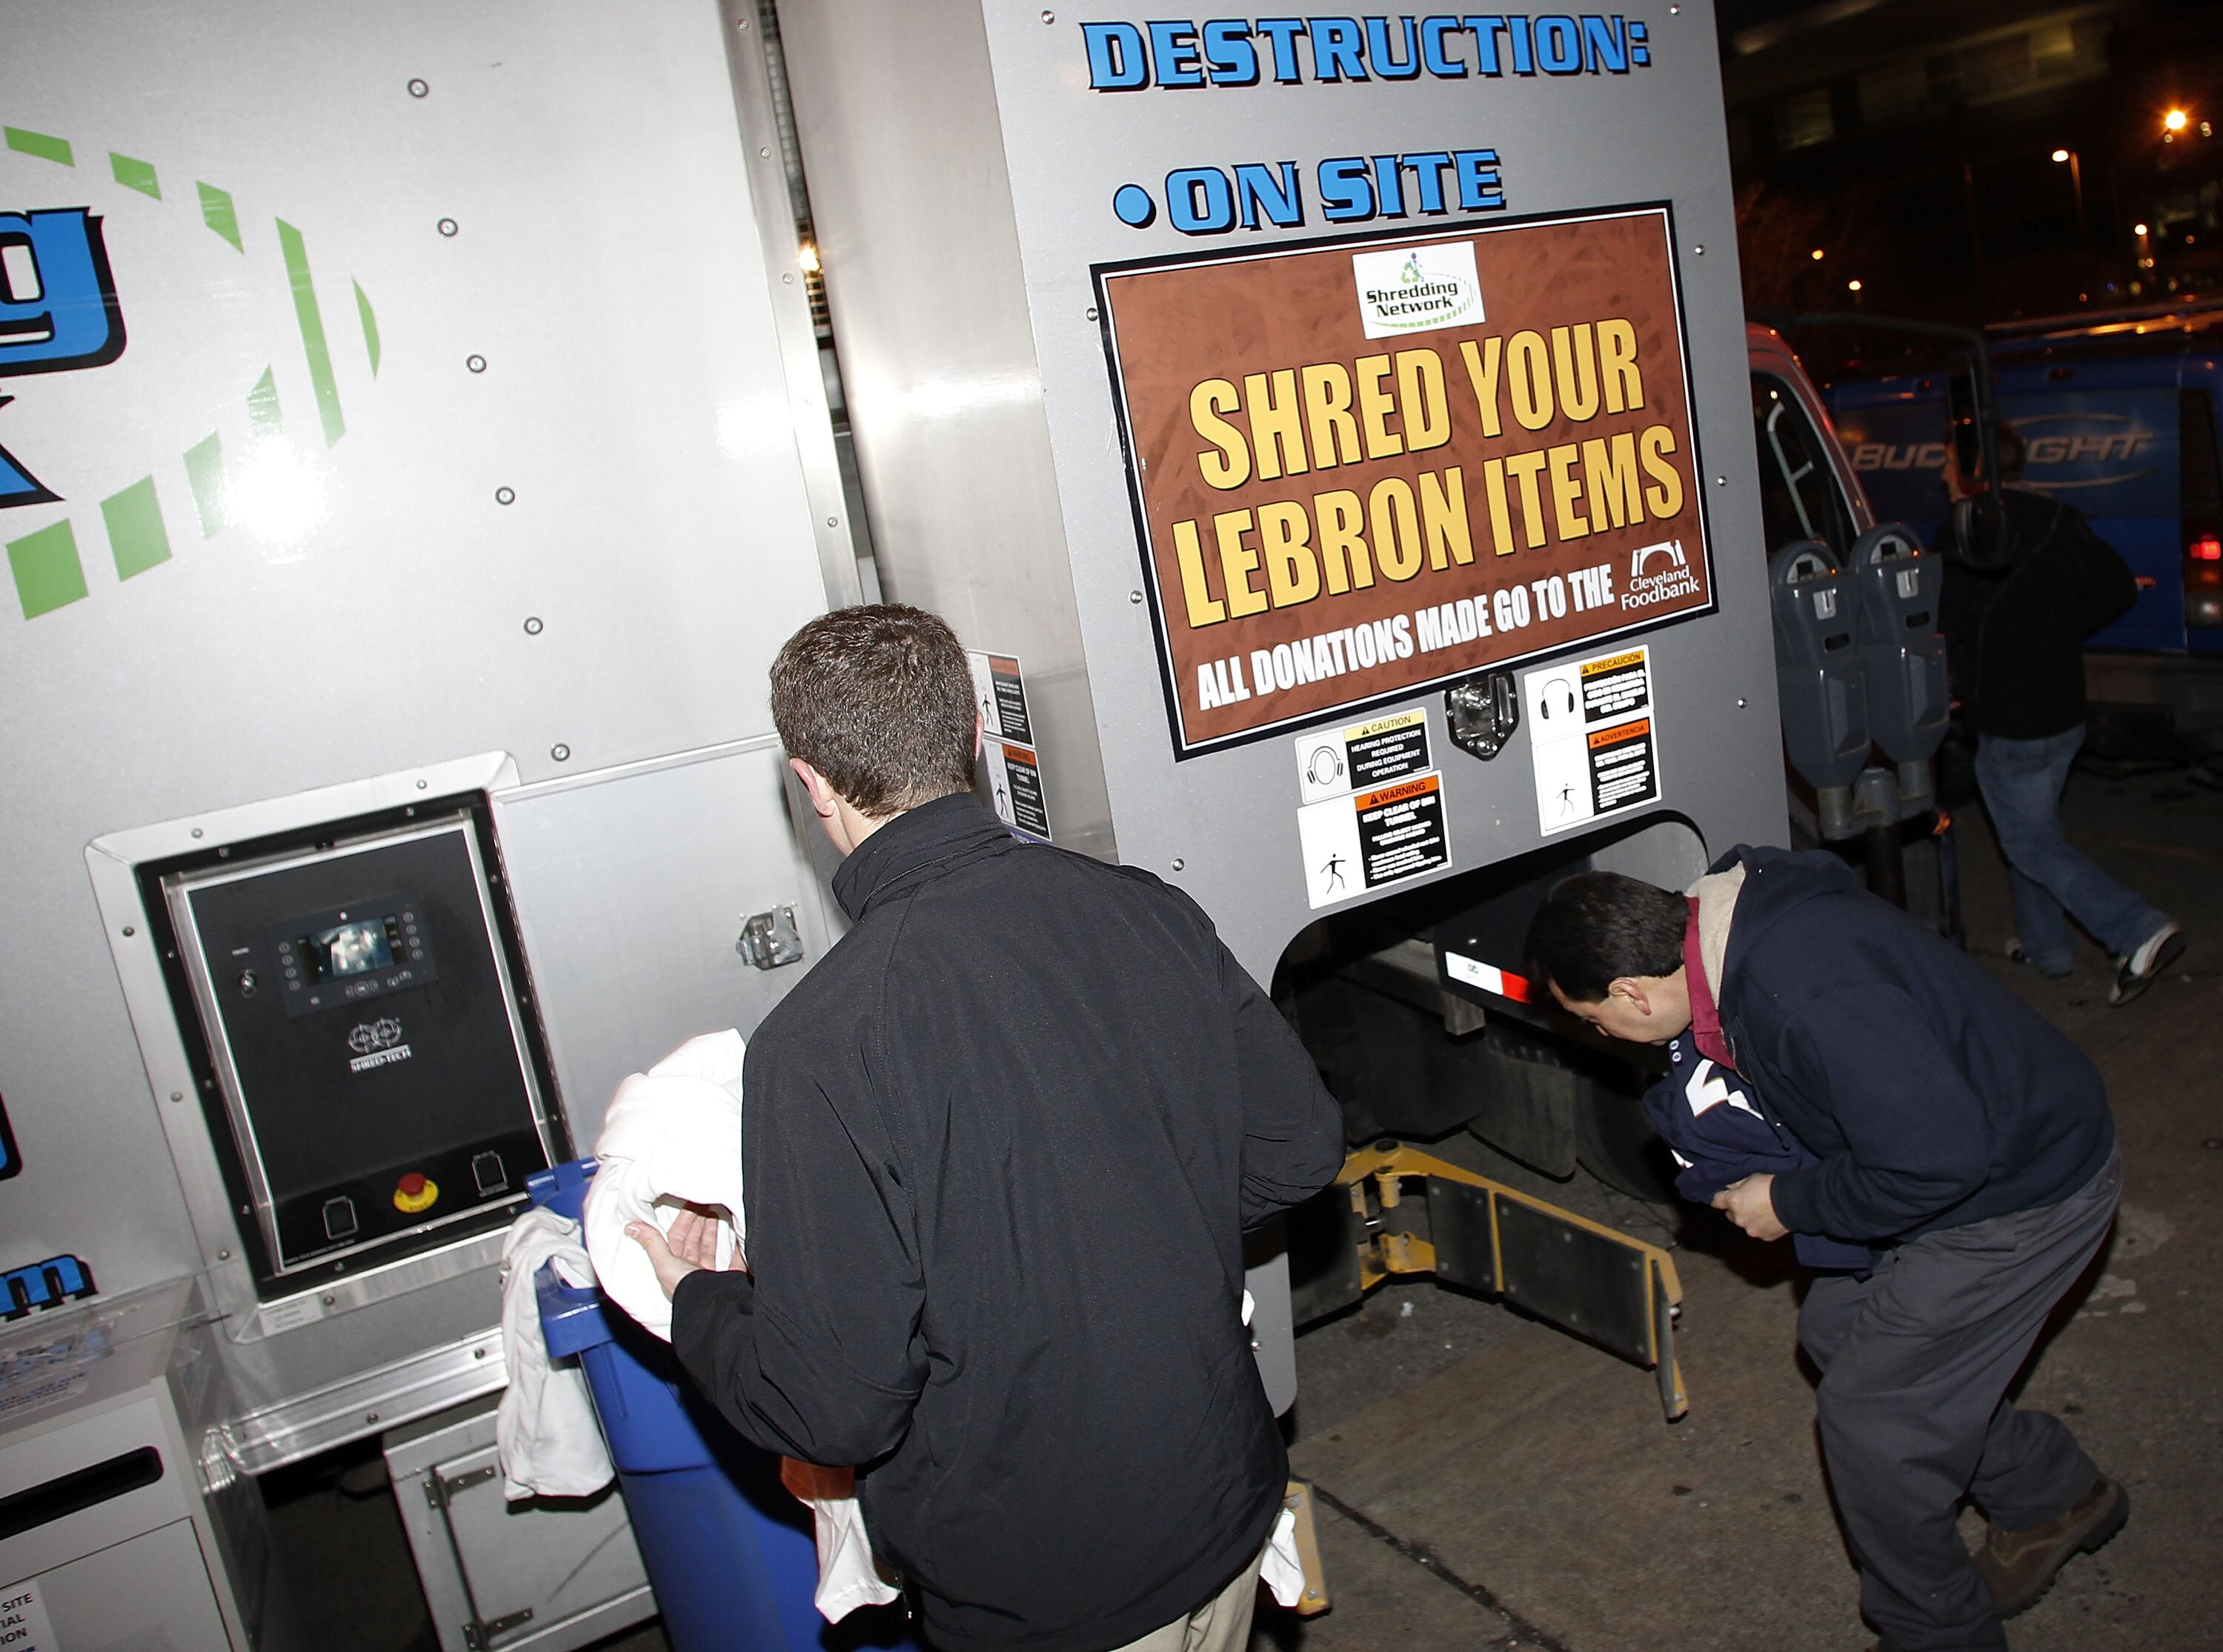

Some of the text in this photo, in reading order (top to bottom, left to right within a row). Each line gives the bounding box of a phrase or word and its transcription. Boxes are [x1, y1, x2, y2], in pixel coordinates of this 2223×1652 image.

[1080, 15, 1651, 93] DESTRUCTION:
[1164, 148, 1506, 235] ON SITE
[1366, 282, 1458, 304] Shredding
[1376, 296, 1453, 318] Network
[1189, 319, 1645, 490] SHRED YOUR
[1172, 424, 1684, 629] LEBRON ITEMS
[1629, 564, 1690, 592] Cleveland
[1621, 576, 1701, 611] Foodbank
[1197, 563, 1615, 712] ALL DONATIONS MADE GO TO THE
[1592, 653, 1641, 672] PRECAUCIÓN
[1371, 715, 1411, 733] CAUTION
[1601, 725, 1645, 742] ADVERTENCIA
[1351, 729, 1422, 753] HEARING PROTECTION
[1371, 743, 1404, 758] REQUIRED
[1356, 749, 1420, 772] DURING EQUIPMENT
[1372, 762, 1409, 778] OPERATION
[1380, 782, 1426, 802] WARNING
[1383, 803, 1409, 817] CLEAR
[1, 1593, 33, 1613] SITE
